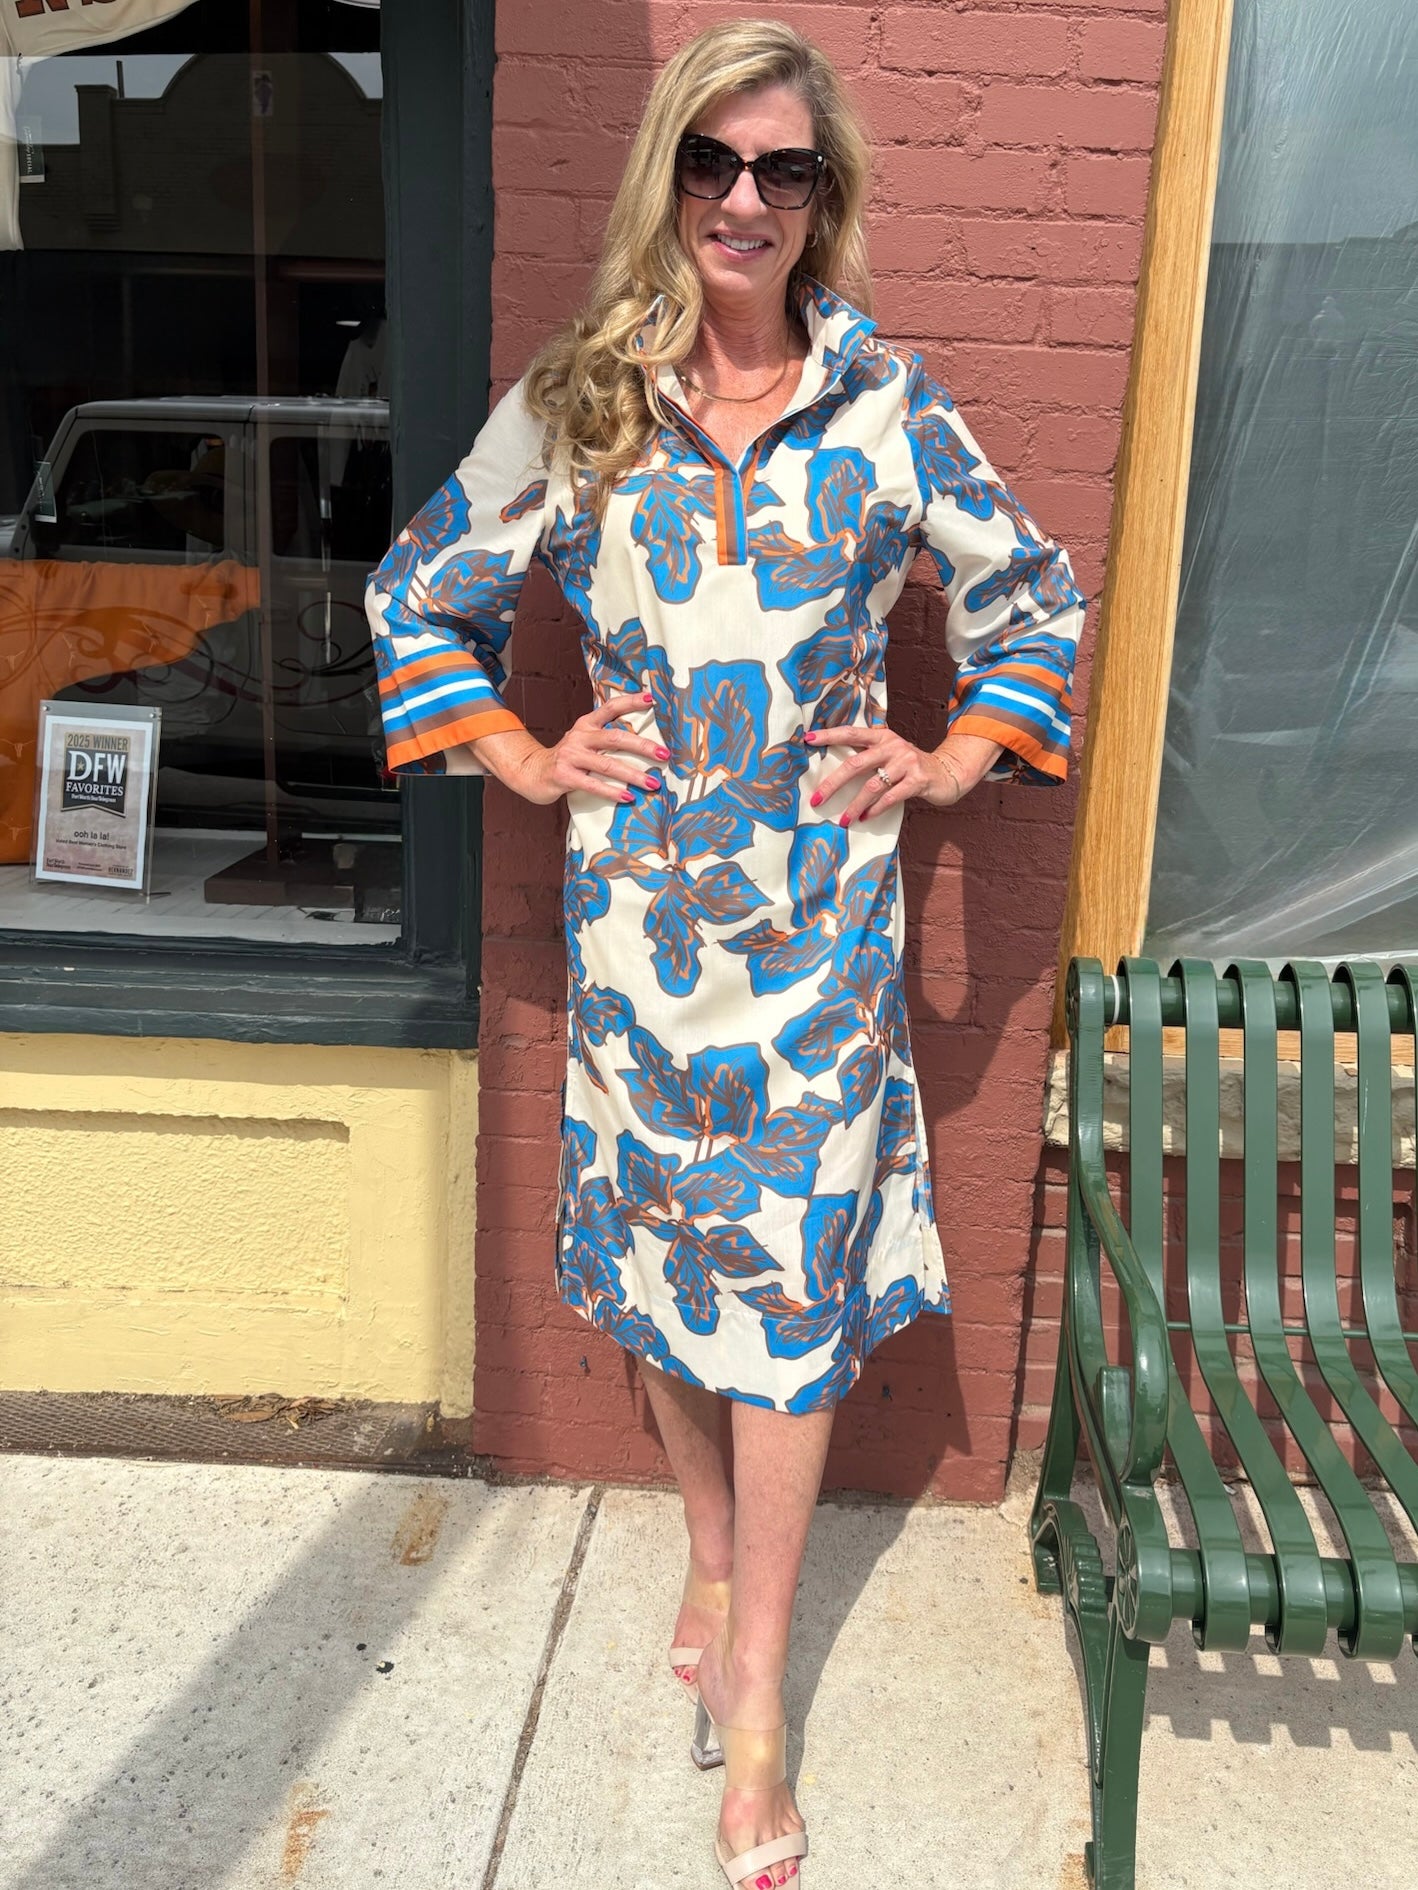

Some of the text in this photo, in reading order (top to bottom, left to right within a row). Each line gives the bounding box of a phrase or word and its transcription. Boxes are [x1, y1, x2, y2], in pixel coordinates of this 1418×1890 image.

[67, 734, 128, 751] 2025 WINNER
[67, 750, 126, 784] DFW
[66, 782, 123, 796] FAVORITES
[74, 830, 89, 838] ooh
[90, 831, 98, 840] la
